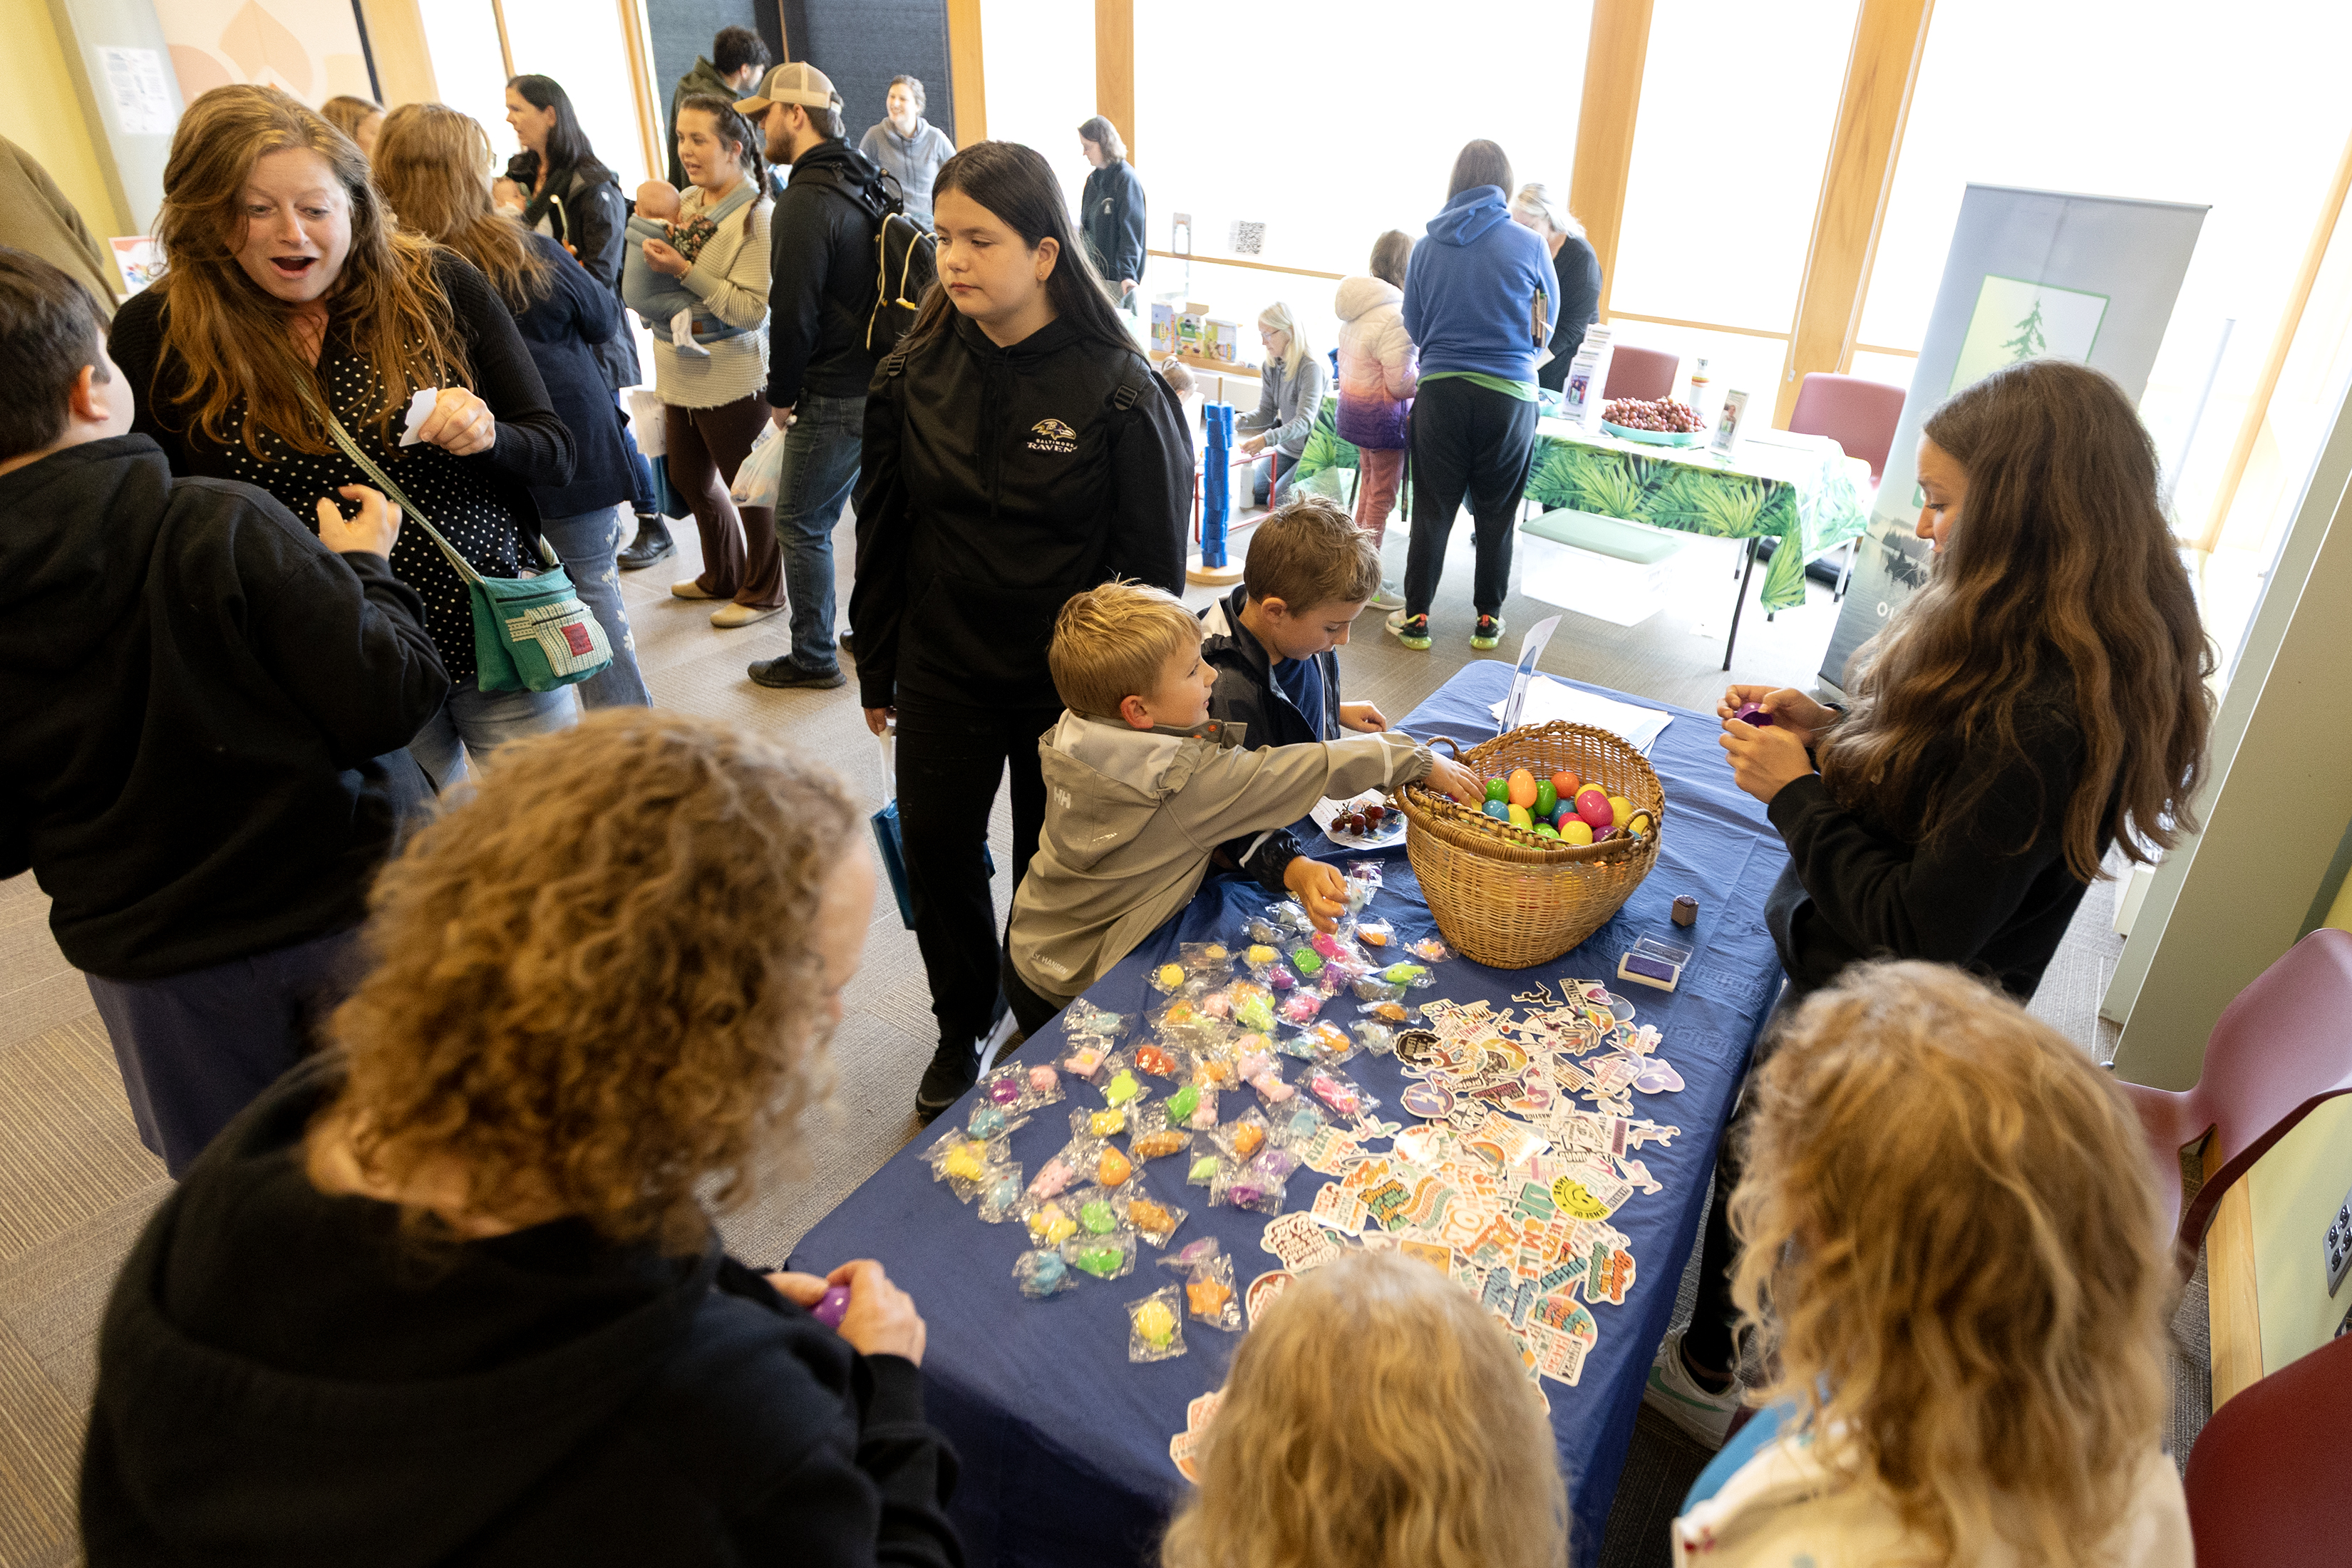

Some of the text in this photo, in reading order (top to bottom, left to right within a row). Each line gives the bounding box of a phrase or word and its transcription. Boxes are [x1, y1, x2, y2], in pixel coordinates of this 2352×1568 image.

[1027, 442, 1078, 453] RAVENS
[1036, 438, 1074, 448] BALTIMORE
[1041, 956, 1069, 975] HANSEN
[1449, 1079, 1482, 1093] protect
[1306, 1128, 1333, 1161] EVERY
[1586, 1208, 1608, 1219] SENSE
[1588, 1242, 1609, 1299] Impossible
[1600, 1257, 1612, 1294] in the
[1610, 1250, 1632, 1300] Believe
[1543, 1334, 1570, 1374] HARD
[1557, 1339, 1582, 1378] WORK
